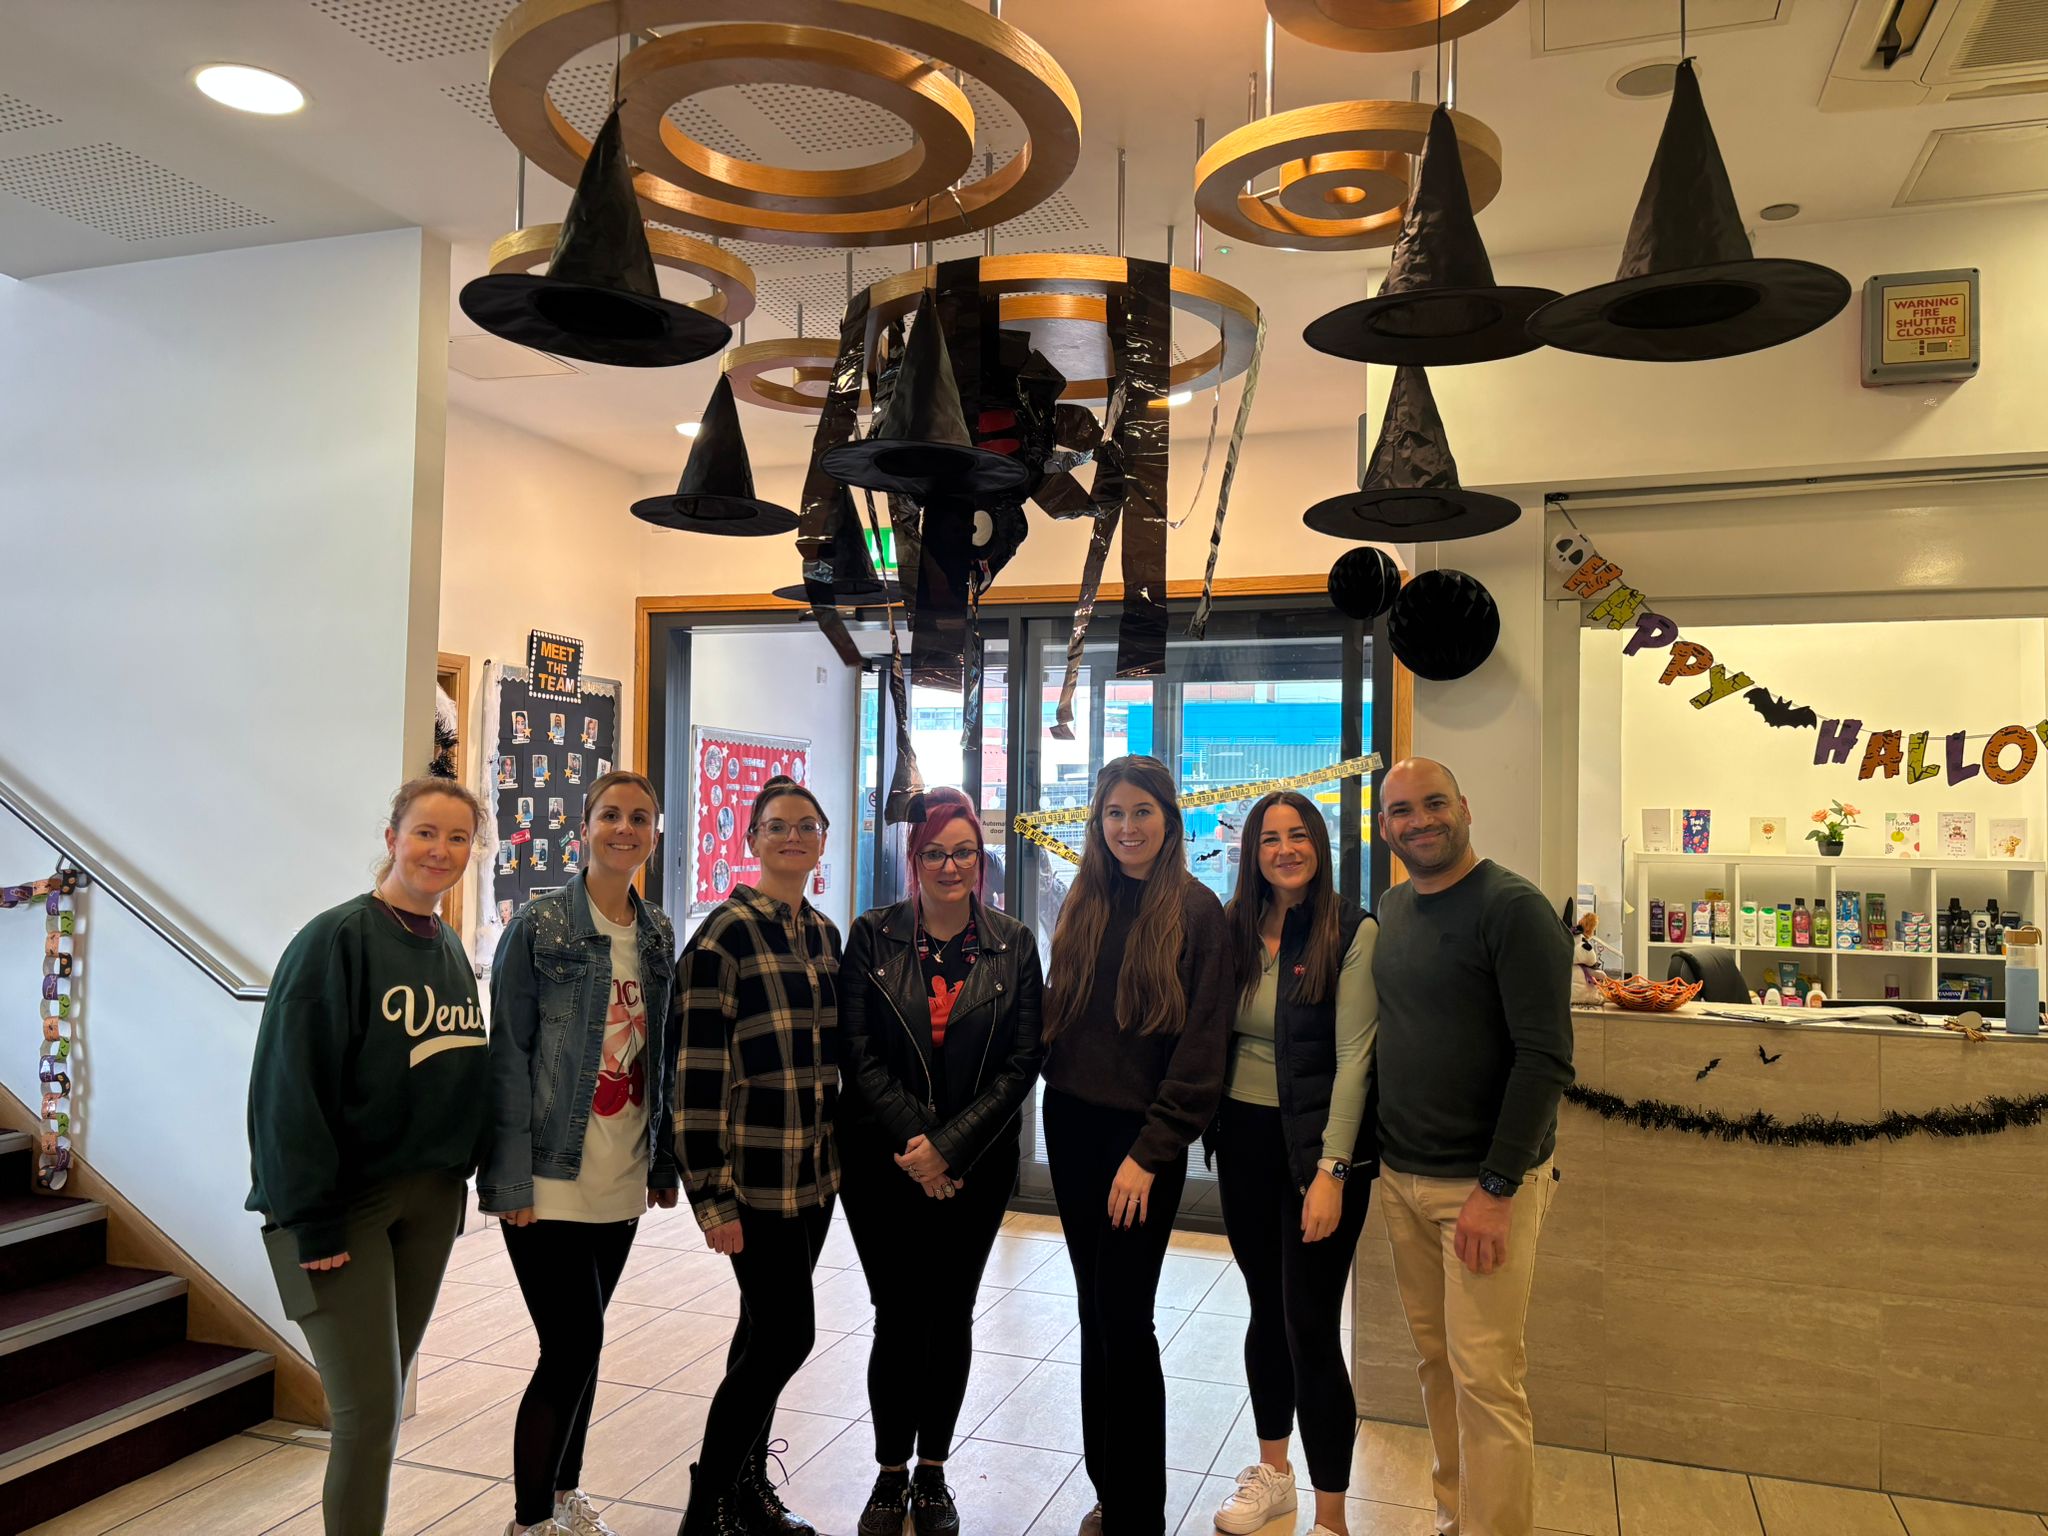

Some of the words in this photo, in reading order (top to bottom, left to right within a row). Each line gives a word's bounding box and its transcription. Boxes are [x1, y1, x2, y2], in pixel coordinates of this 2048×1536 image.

[1894, 297, 1959, 309] WARNING
[1913, 308, 1940, 317] FIRE
[1896, 316, 1957, 328] SHUTTER
[1897, 326, 1956, 337] CLOSING
[541, 641, 576, 662] MEET
[547, 661, 568, 676] THE
[1563, 555, 1755, 709] HAPPY
[1814, 719, 2048, 787] HALLO
[538, 673, 575, 693] TEAM
